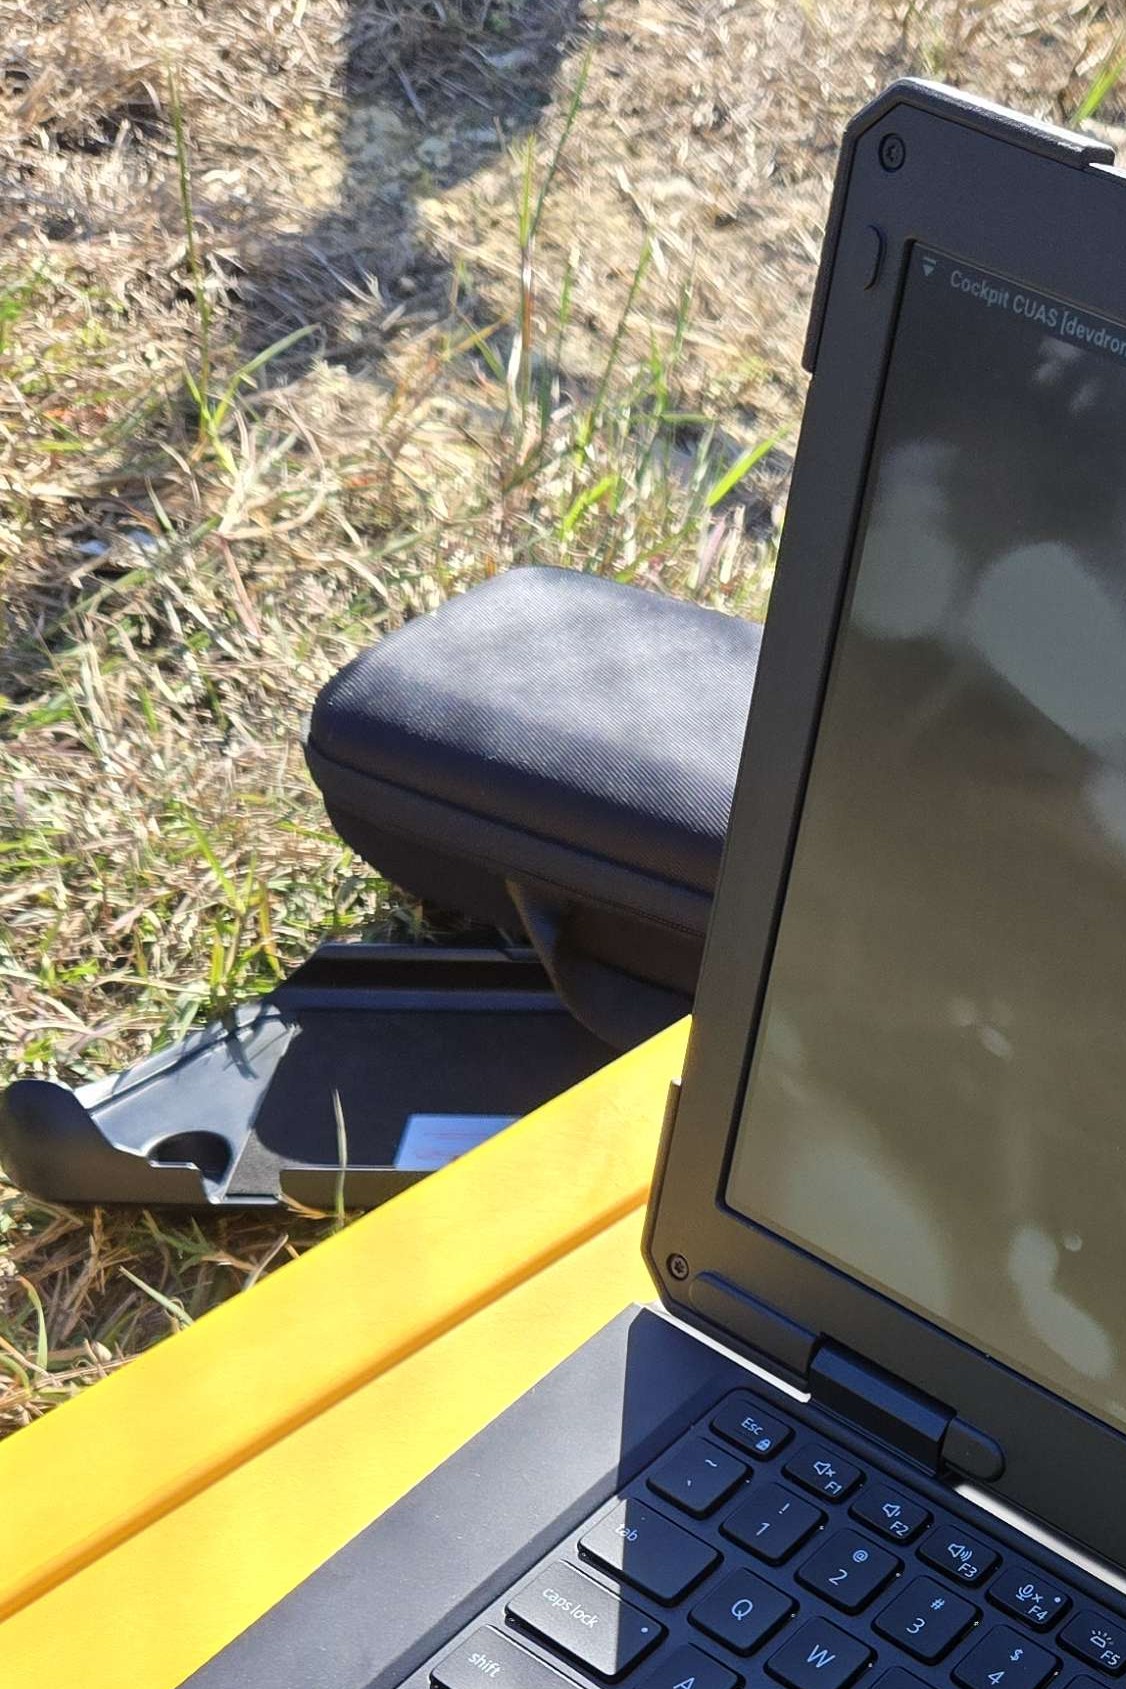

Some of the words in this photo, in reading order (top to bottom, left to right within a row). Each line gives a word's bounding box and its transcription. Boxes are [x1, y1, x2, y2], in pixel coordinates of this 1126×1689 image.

[950, 270, 1008, 310] Cockpit
[1012, 294, 1057, 328] CUAS
[741, 1417, 763, 1436] Esc
[824, 1480, 843, 1495] F1
[615, 1523, 638, 1541] tab
[756, 1522, 770, 1536] 1
[889, 1520, 909, 1536] F2
[852, 1549, 869, 1563] @
[828, 1568, 848, 1586] 2
[957, 1562, 978, 1578] F3
[542, 1588, 573, 1609] caps
[570, 1604, 598, 1628] lock
[731, 1599, 753, 1621] Q
[930, 1598, 945, 1610] #
[1027, 1604, 1048, 1621] F4
[906, 1617, 926, 1634] 3
[807, 1644, 836, 1668] W
[1009, 1648, 1024, 1661] $
[1100, 1649, 1121, 1666] F5
[468, 1653, 501, 1677] shift
[987, 1671, 1005, 1685] 4
